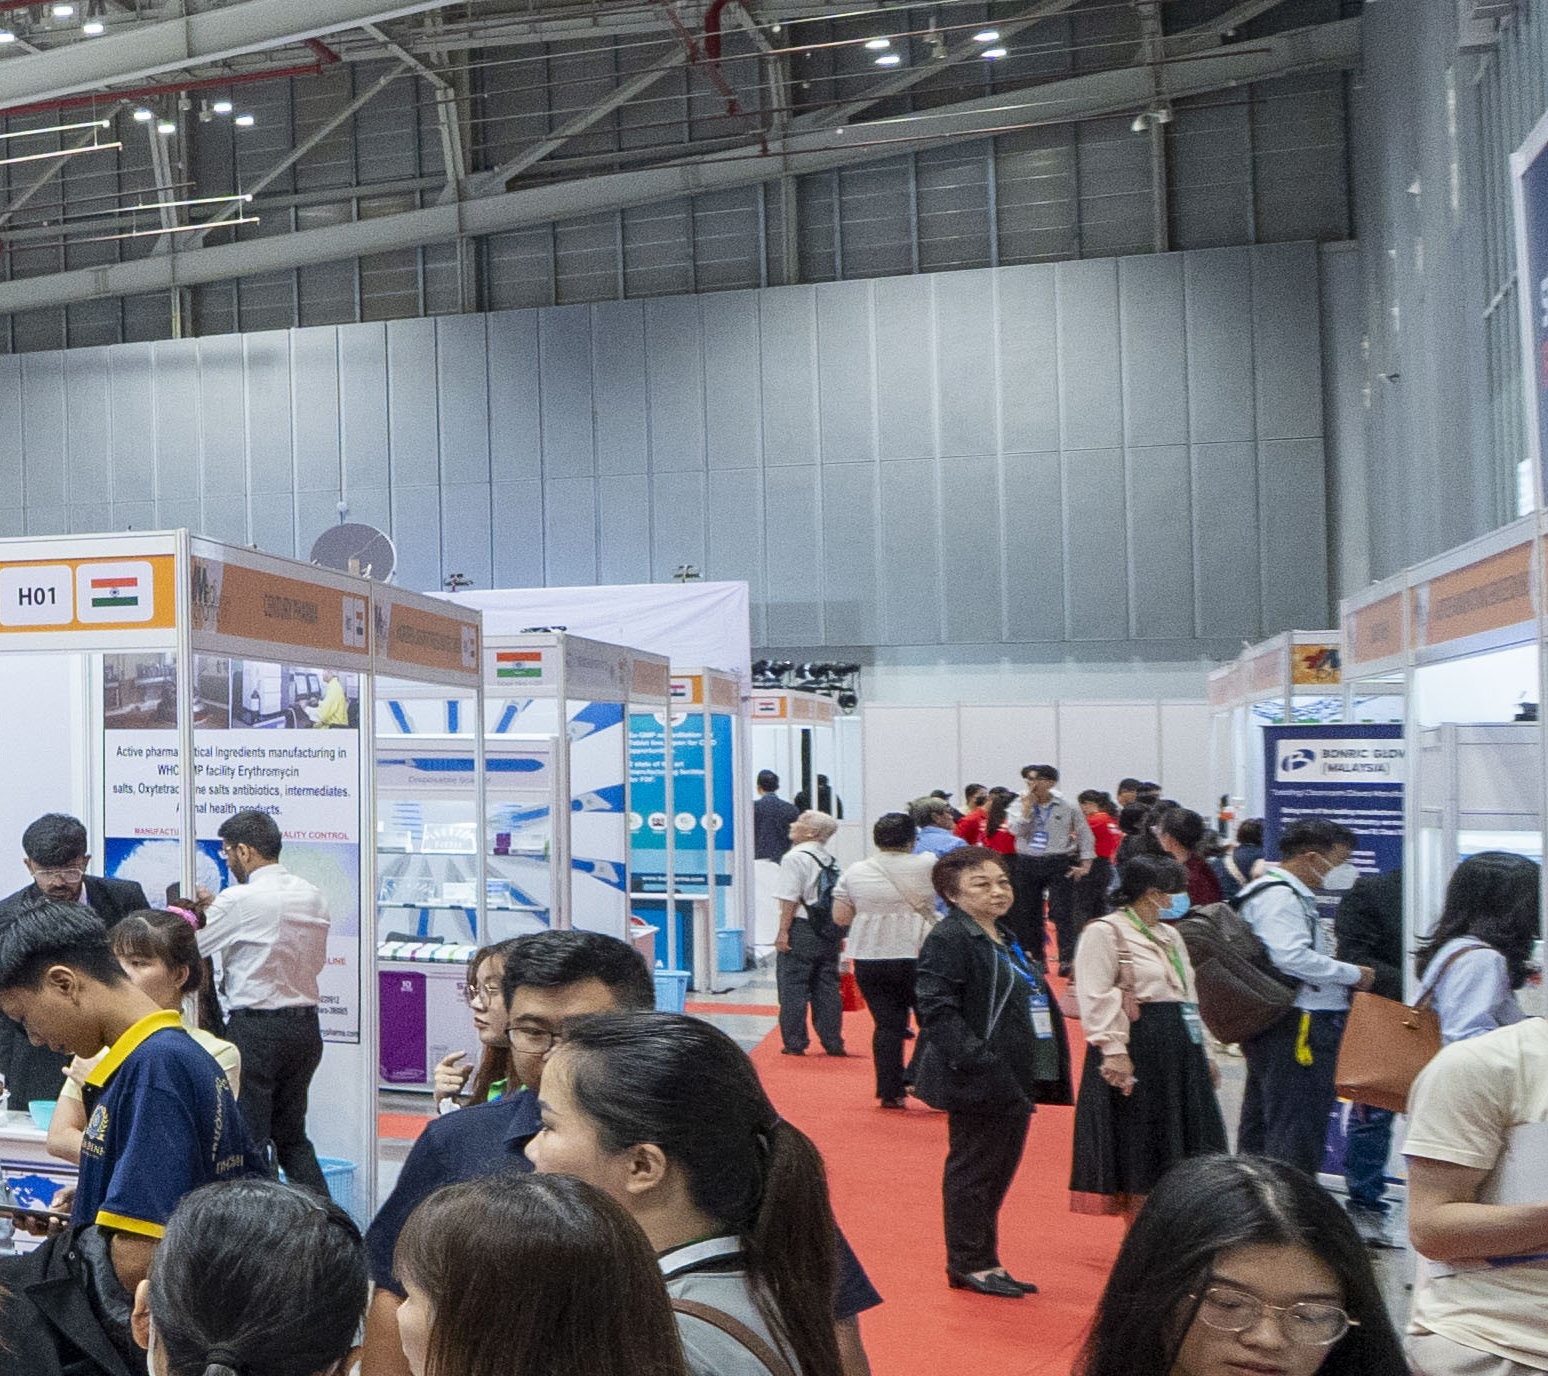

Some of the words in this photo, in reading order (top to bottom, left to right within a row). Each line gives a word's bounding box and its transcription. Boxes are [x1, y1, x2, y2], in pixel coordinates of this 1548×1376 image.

[18, 587, 57, 605] H01
[215, 746, 266, 760] Ingredients
[269, 747, 334, 761] manufacturing
[338, 747, 346, 758] in
[206, 765, 235, 779] facility
[238, 766, 299, 779] Erythromycin
